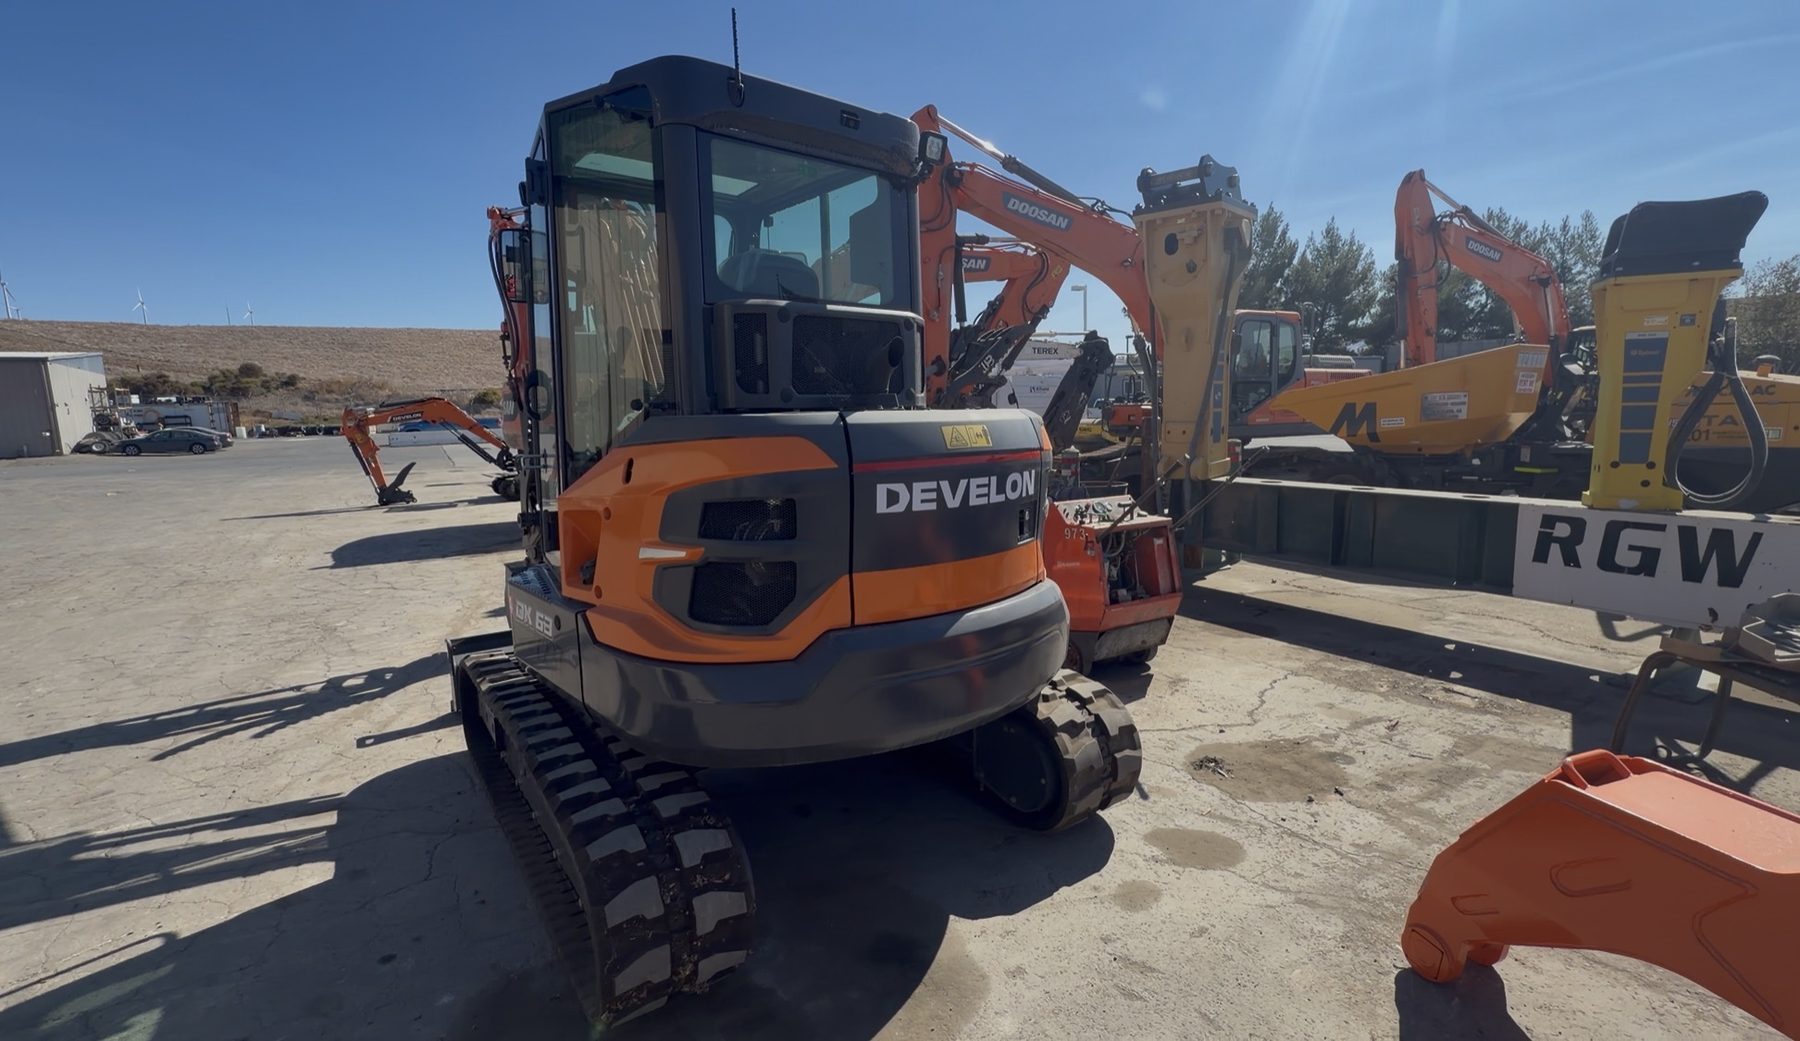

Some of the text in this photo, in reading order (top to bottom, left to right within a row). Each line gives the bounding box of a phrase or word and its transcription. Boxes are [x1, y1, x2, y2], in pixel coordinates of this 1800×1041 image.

[1007, 198, 1069, 230] DOOSAN
[961, 257, 986, 270] SAN
[1467, 240, 1502, 261] DOOSAN
[1032, 346, 1059, 355] TEREX
[876, 469, 1036, 514] DEVELON
[1531, 513, 1764, 588] RGW
